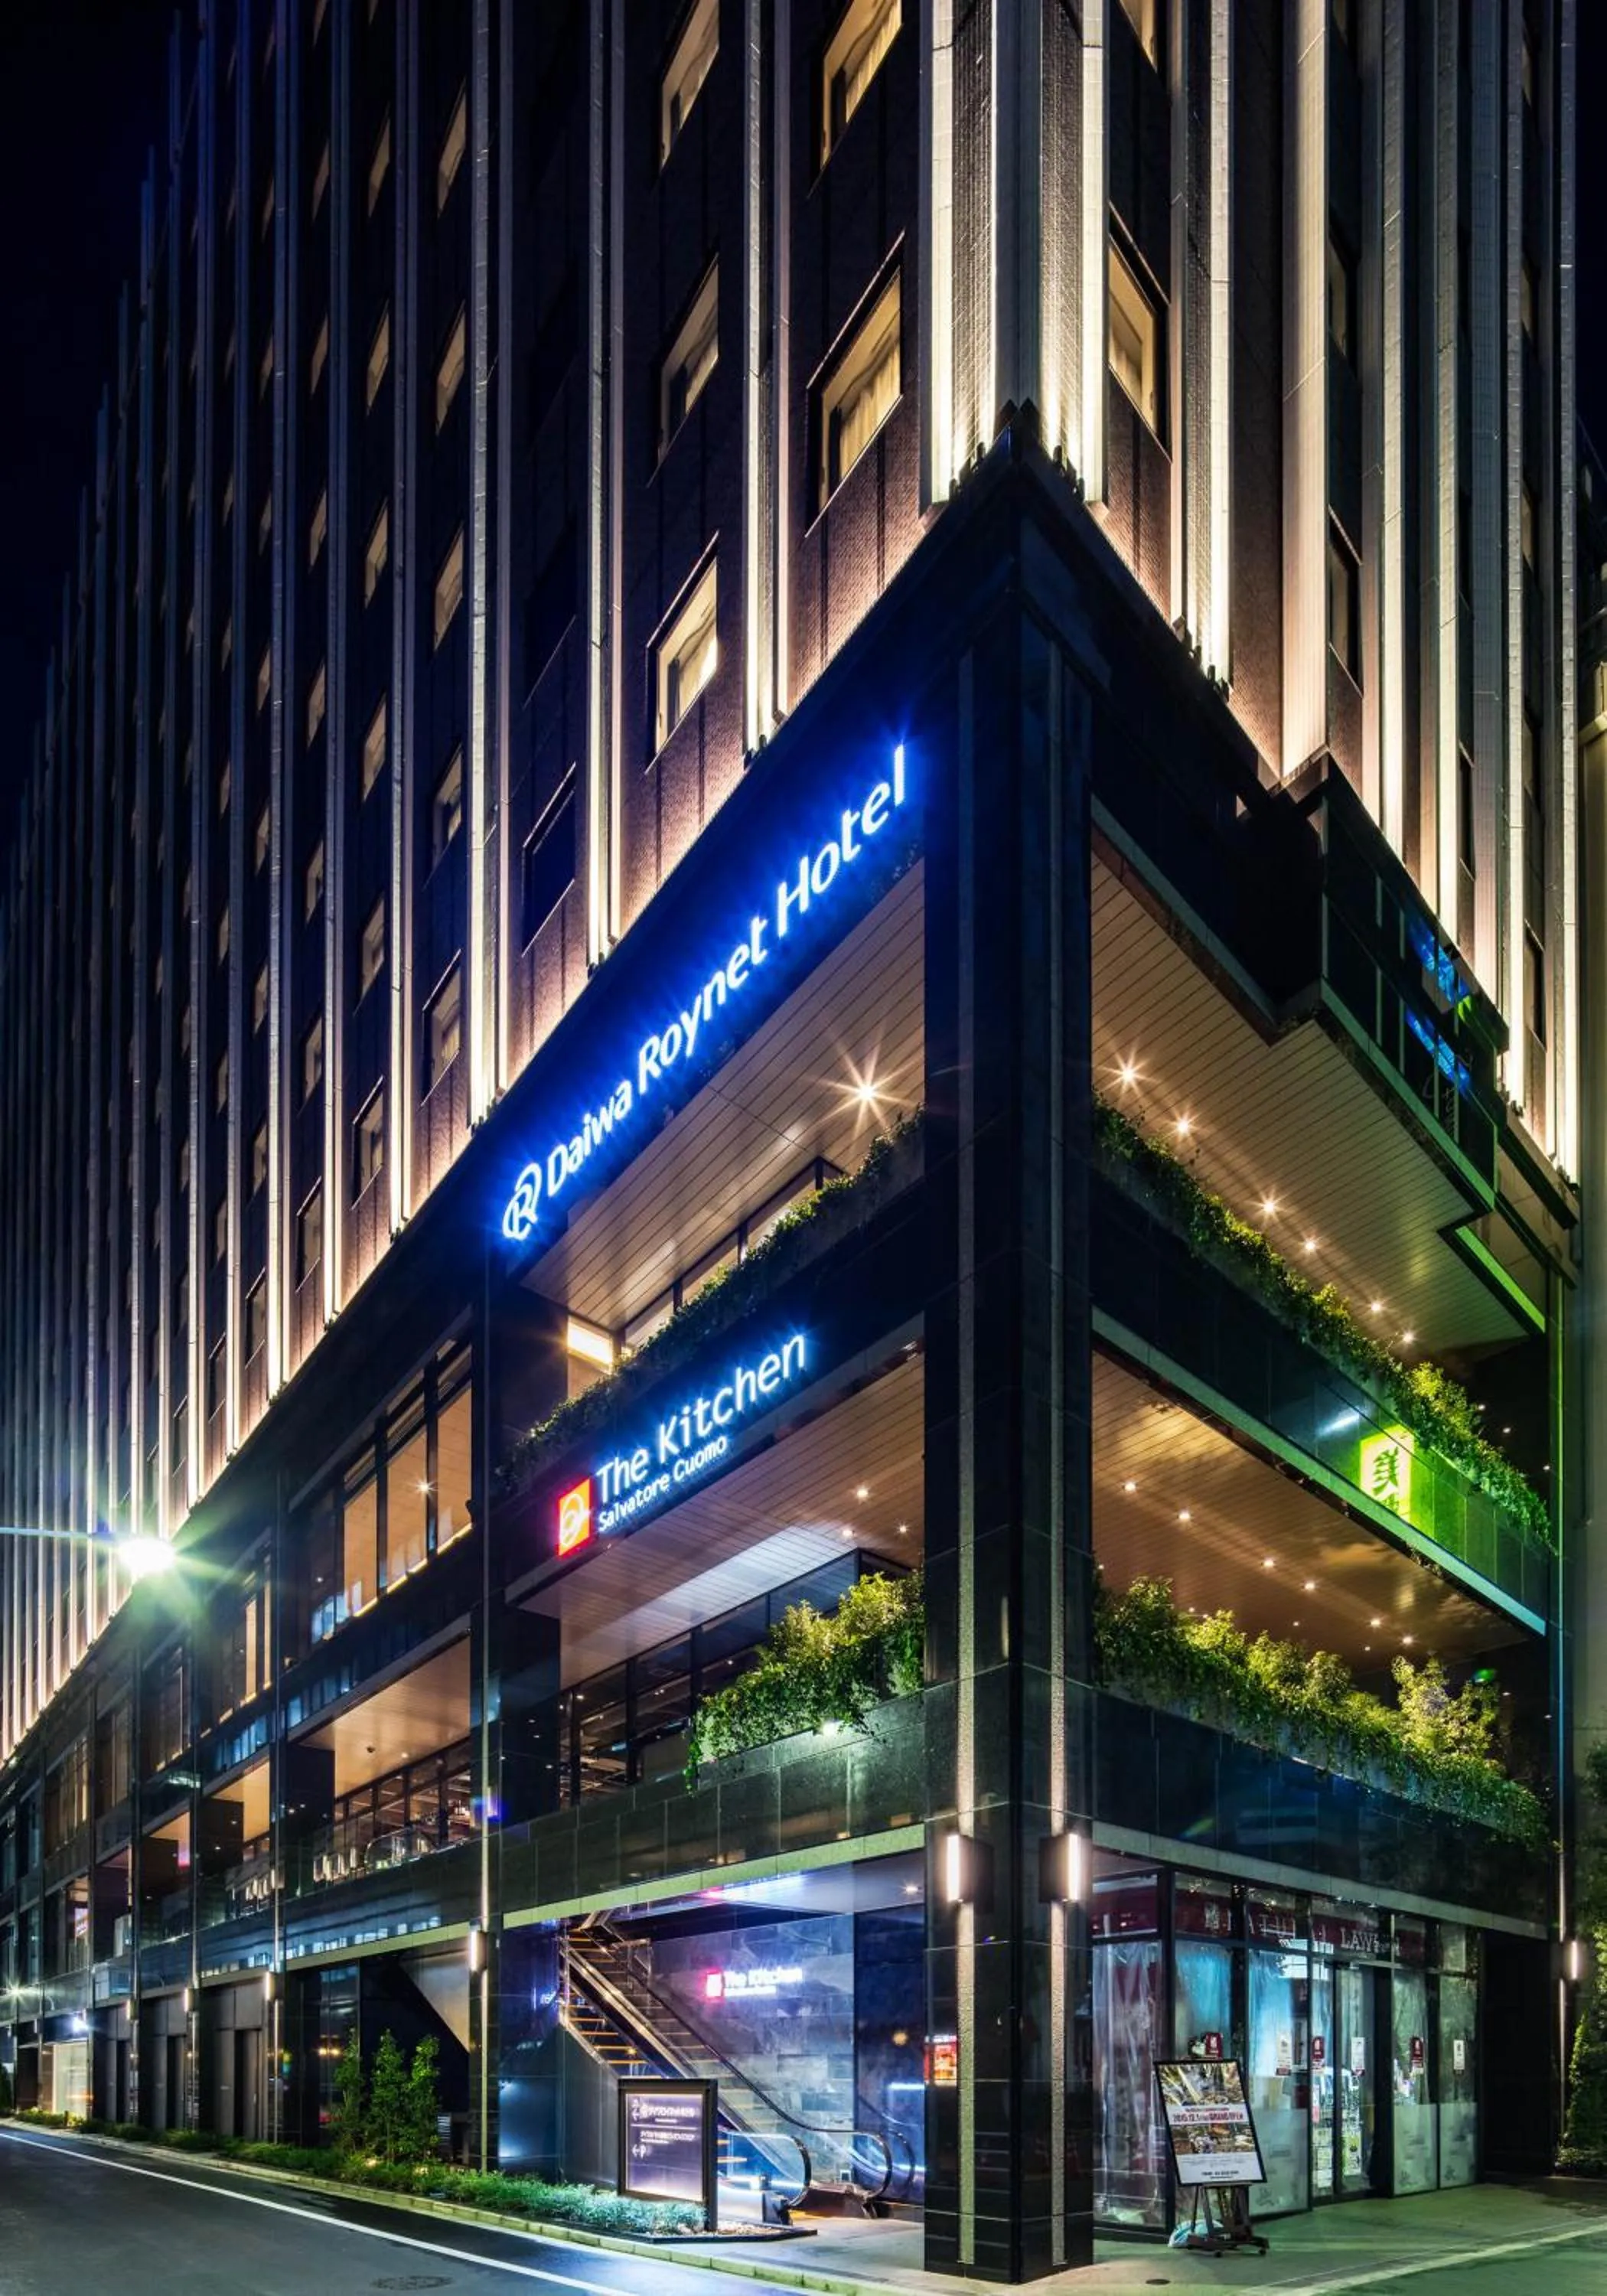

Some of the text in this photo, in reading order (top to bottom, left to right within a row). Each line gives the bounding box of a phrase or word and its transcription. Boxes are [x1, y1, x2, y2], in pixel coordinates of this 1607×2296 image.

[547, 1079, 632, 1197] Daiwa
[638, 916, 768, 1094] Roynet
[777, 744, 905, 938] Hotel
[595, 1334, 805, 1504] The Kitchen
[598, 1435, 729, 1532] Salvatore Cuomo
